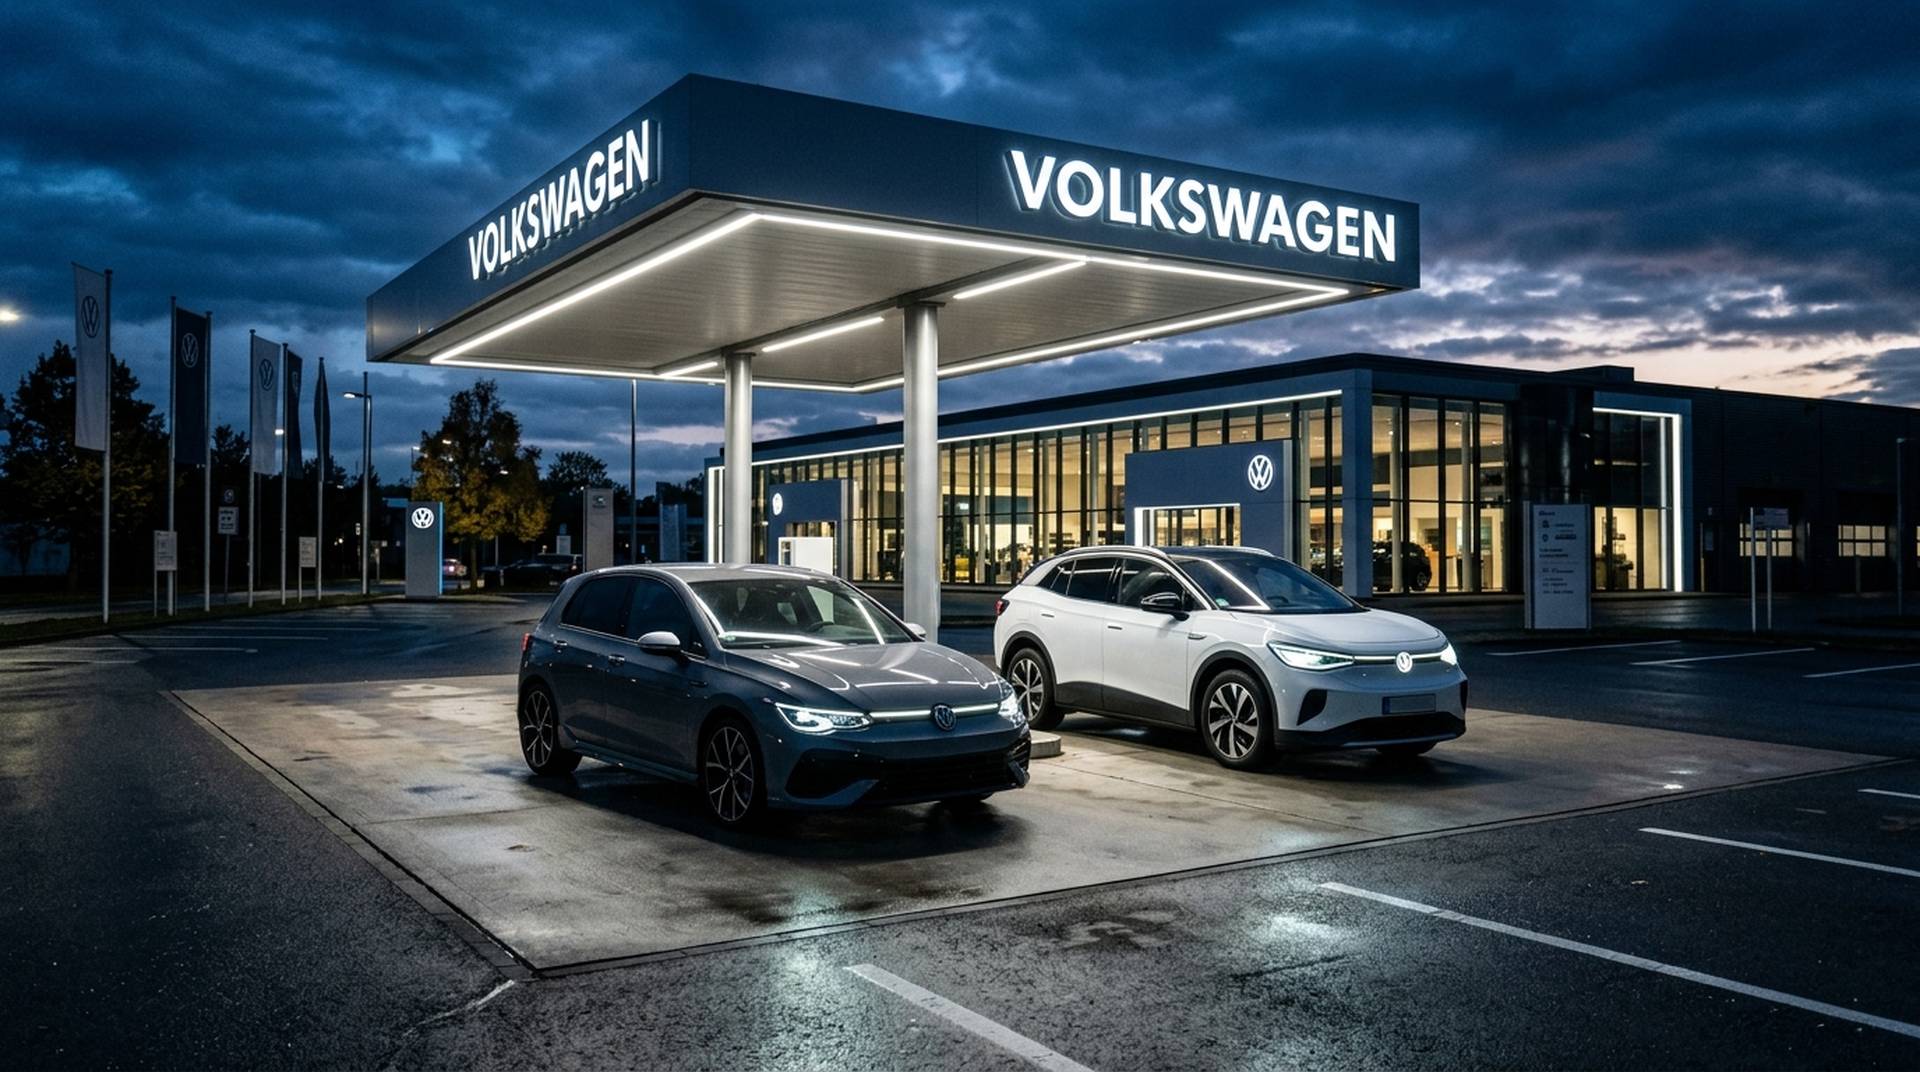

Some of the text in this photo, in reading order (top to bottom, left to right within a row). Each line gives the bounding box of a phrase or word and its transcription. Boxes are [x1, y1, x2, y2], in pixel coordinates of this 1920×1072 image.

[468, 119, 649, 280] VOLKSWAGEN
[1009, 150, 1396, 262] VOLKSWAGEN
[1247, 454, 1273, 491] VW
